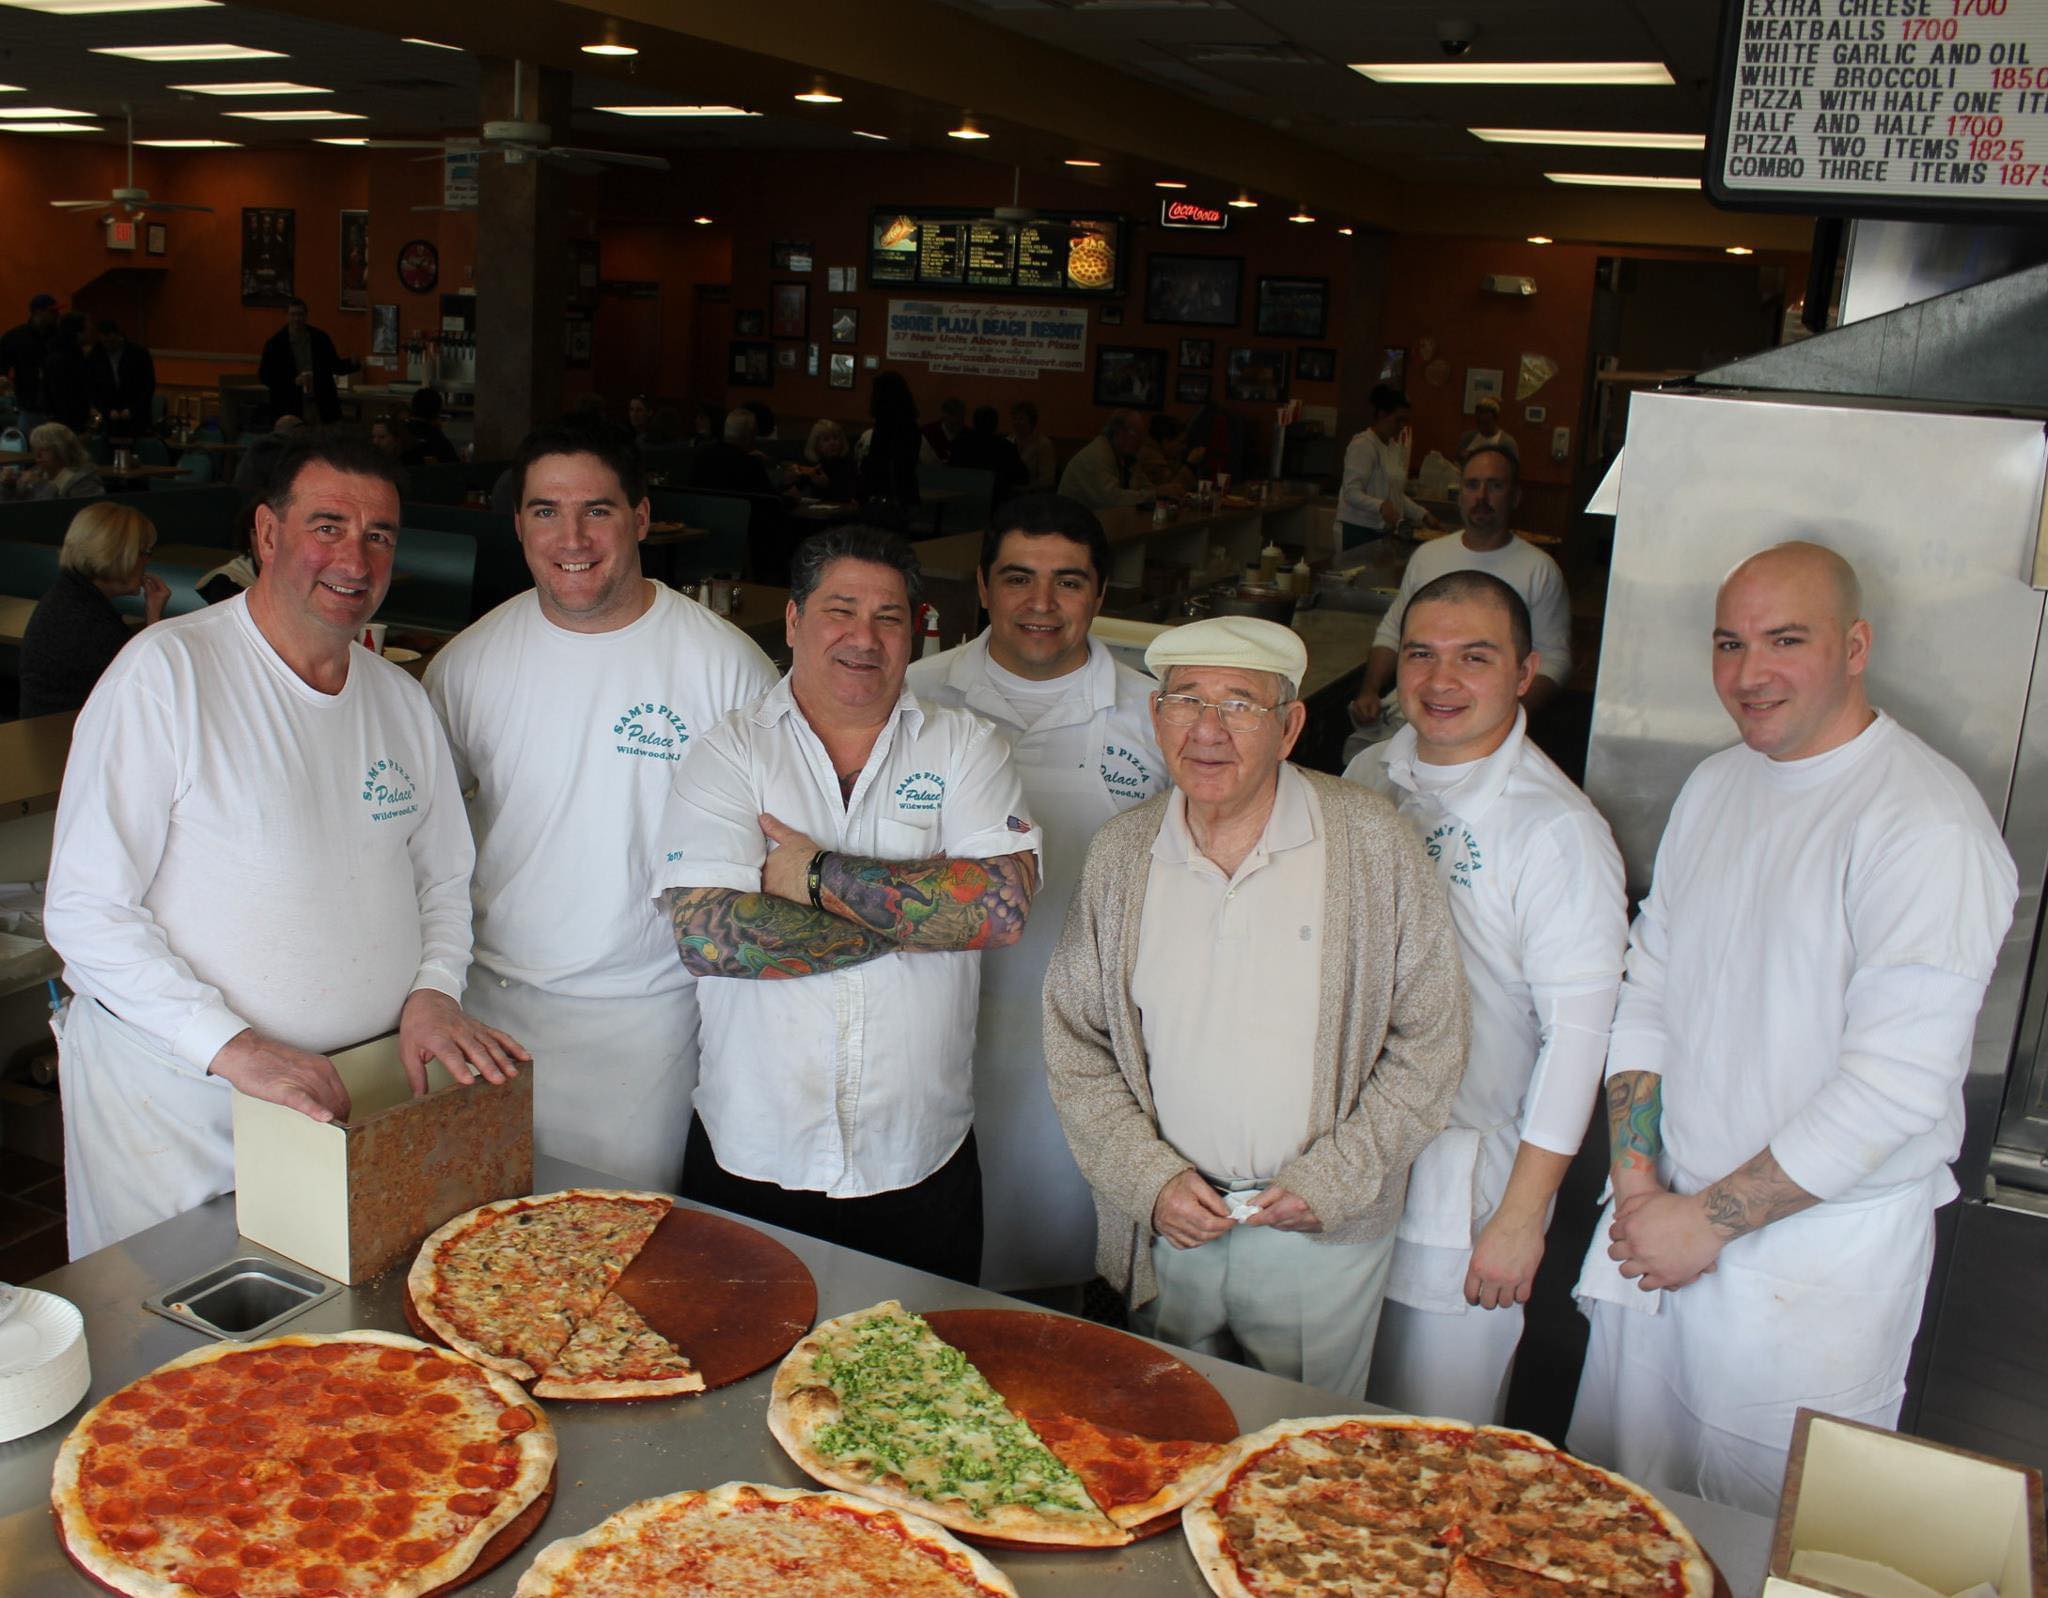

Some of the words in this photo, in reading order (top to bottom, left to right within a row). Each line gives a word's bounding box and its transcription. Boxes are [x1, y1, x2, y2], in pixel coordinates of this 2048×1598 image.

[1748, 0, 1822, 17] EXTRA
[1838, 0, 1931, 17] CHEESE
[1952, 0, 2007, 16] 1700
[1745, 19, 1885, 41] MEATBALLS
[1902, 18, 1958, 41] 1700
[1744, 43, 1820, 64] WHITE
[1833, 43, 1916, 65] GARLIC
[1929, 43, 1981, 65] AND
[1989, 43, 2029, 65] OIL
[1741, 66, 1816, 87] WHITE
[1834, 66, 1956, 89] BROCCOLI
[1991, 67, 2048, 89] 1850
[1739, 89, 1802, 110] PIZZA
[1819, 90, 1877, 111] WITH
[1883, 91, 1943, 112] HALF
[1953, 91, 2003, 113] ONE
[1736, 111, 1796, 132] HALF
[1813, 113, 1860, 134] AND
[1874, 114, 1935, 135] HALF
[1947, 115, 2003, 138] 1700
[1733, 134, 1797, 155] PIZZA
[1818, 136, 1866, 158] TWO
[1884, 138, 1959, 160] ITEMS
[1969, 139, 2025, 161] 1825
[1729, 156, 1805, 178] COMBO
[1819, 159, 1889, 181] THREE
[1910, 161, 1988, 184] ITEMS
[937, 316, 979, 335] PLAZA
[982, 318, 1027, 336] BEACH
[614, 702, 654, 735] SAM'S
[658, 705, 689, 743] PIZZA
[628, 724, 674, 747] Palace
[1118, 747, 1150, 783] PIZZA
[363, 760, 387, 801] SAM'S
[375, 785, 413, 806] Palace
[905, 789, 941, 801] Palace
